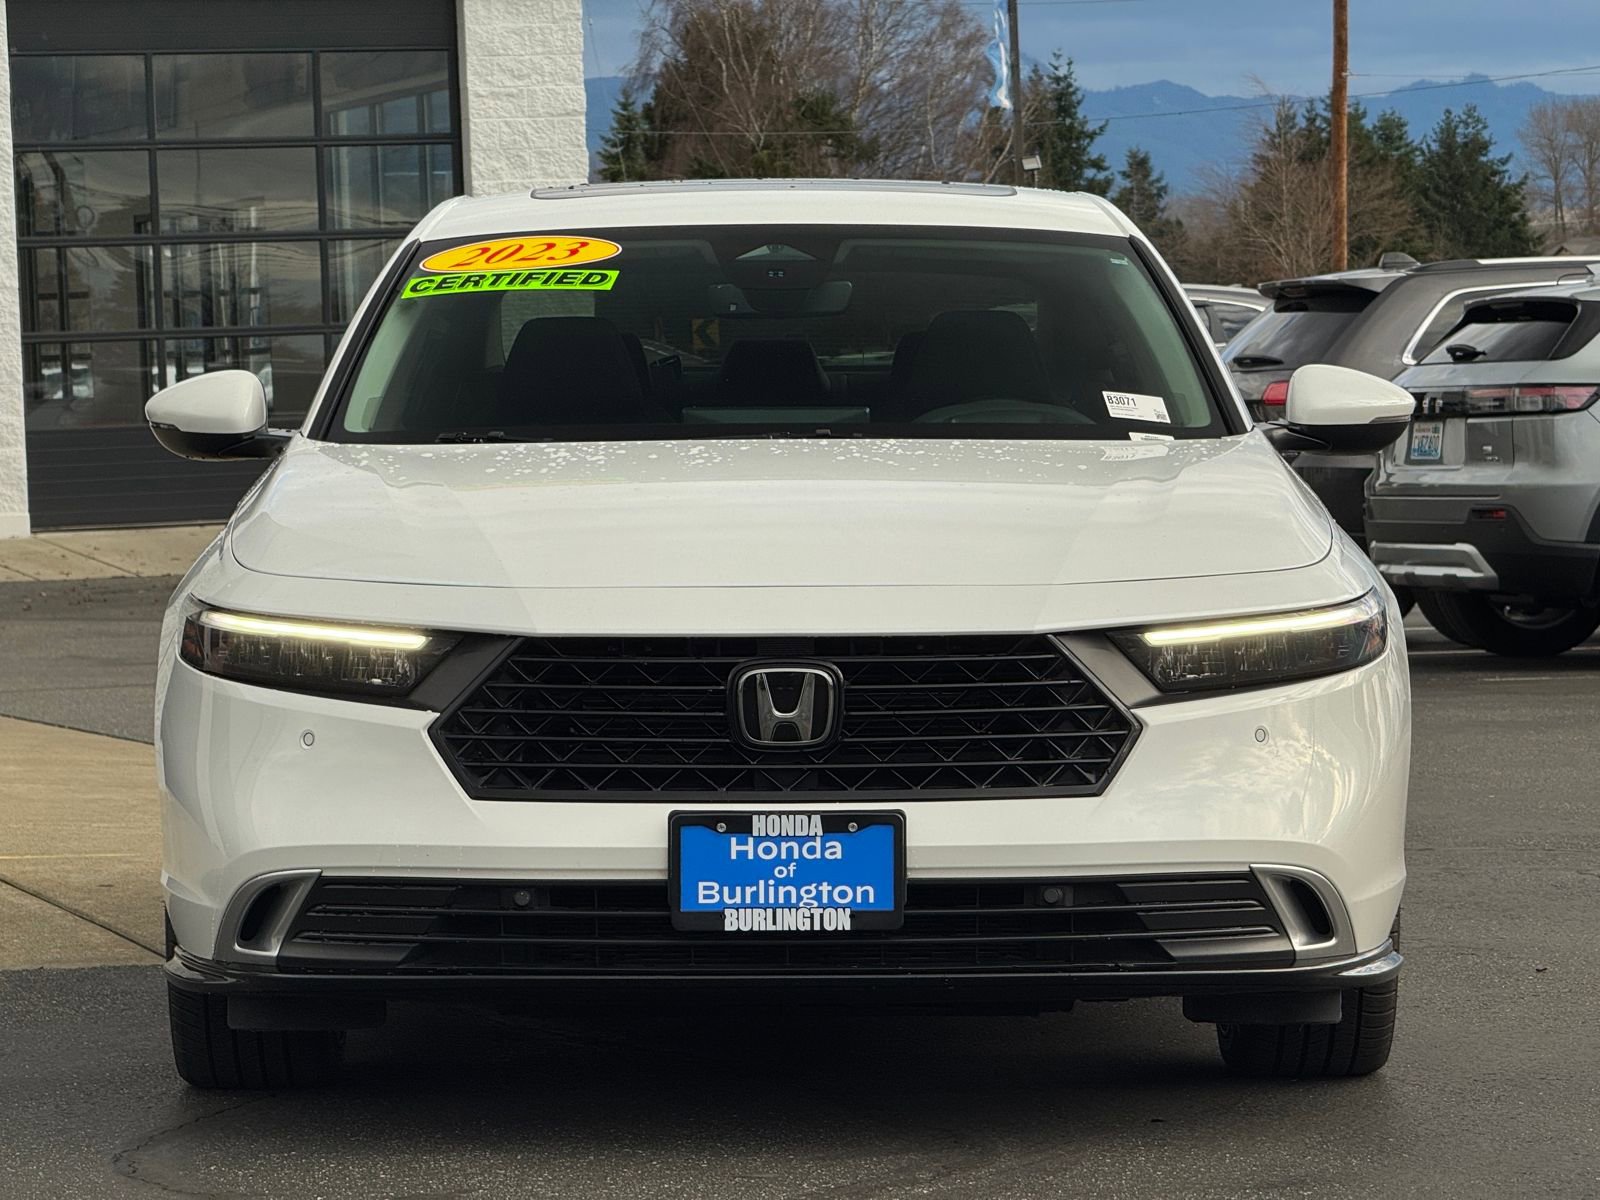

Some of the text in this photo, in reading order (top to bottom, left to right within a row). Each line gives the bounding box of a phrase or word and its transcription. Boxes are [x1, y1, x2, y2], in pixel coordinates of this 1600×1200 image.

[447, 241, 590, 268] 2023
[409, 271, 612, 293] CERTIFIED
[1106, 395, 1137, 407] B3071
[752, 814, 823, 837] HONDA
[730, 836, 842, 860] Honda
[773, 862, 797, 878] of
[697, 880, 875, 908] Burlington
[724, 907, 851, 931] BURLINGTON
